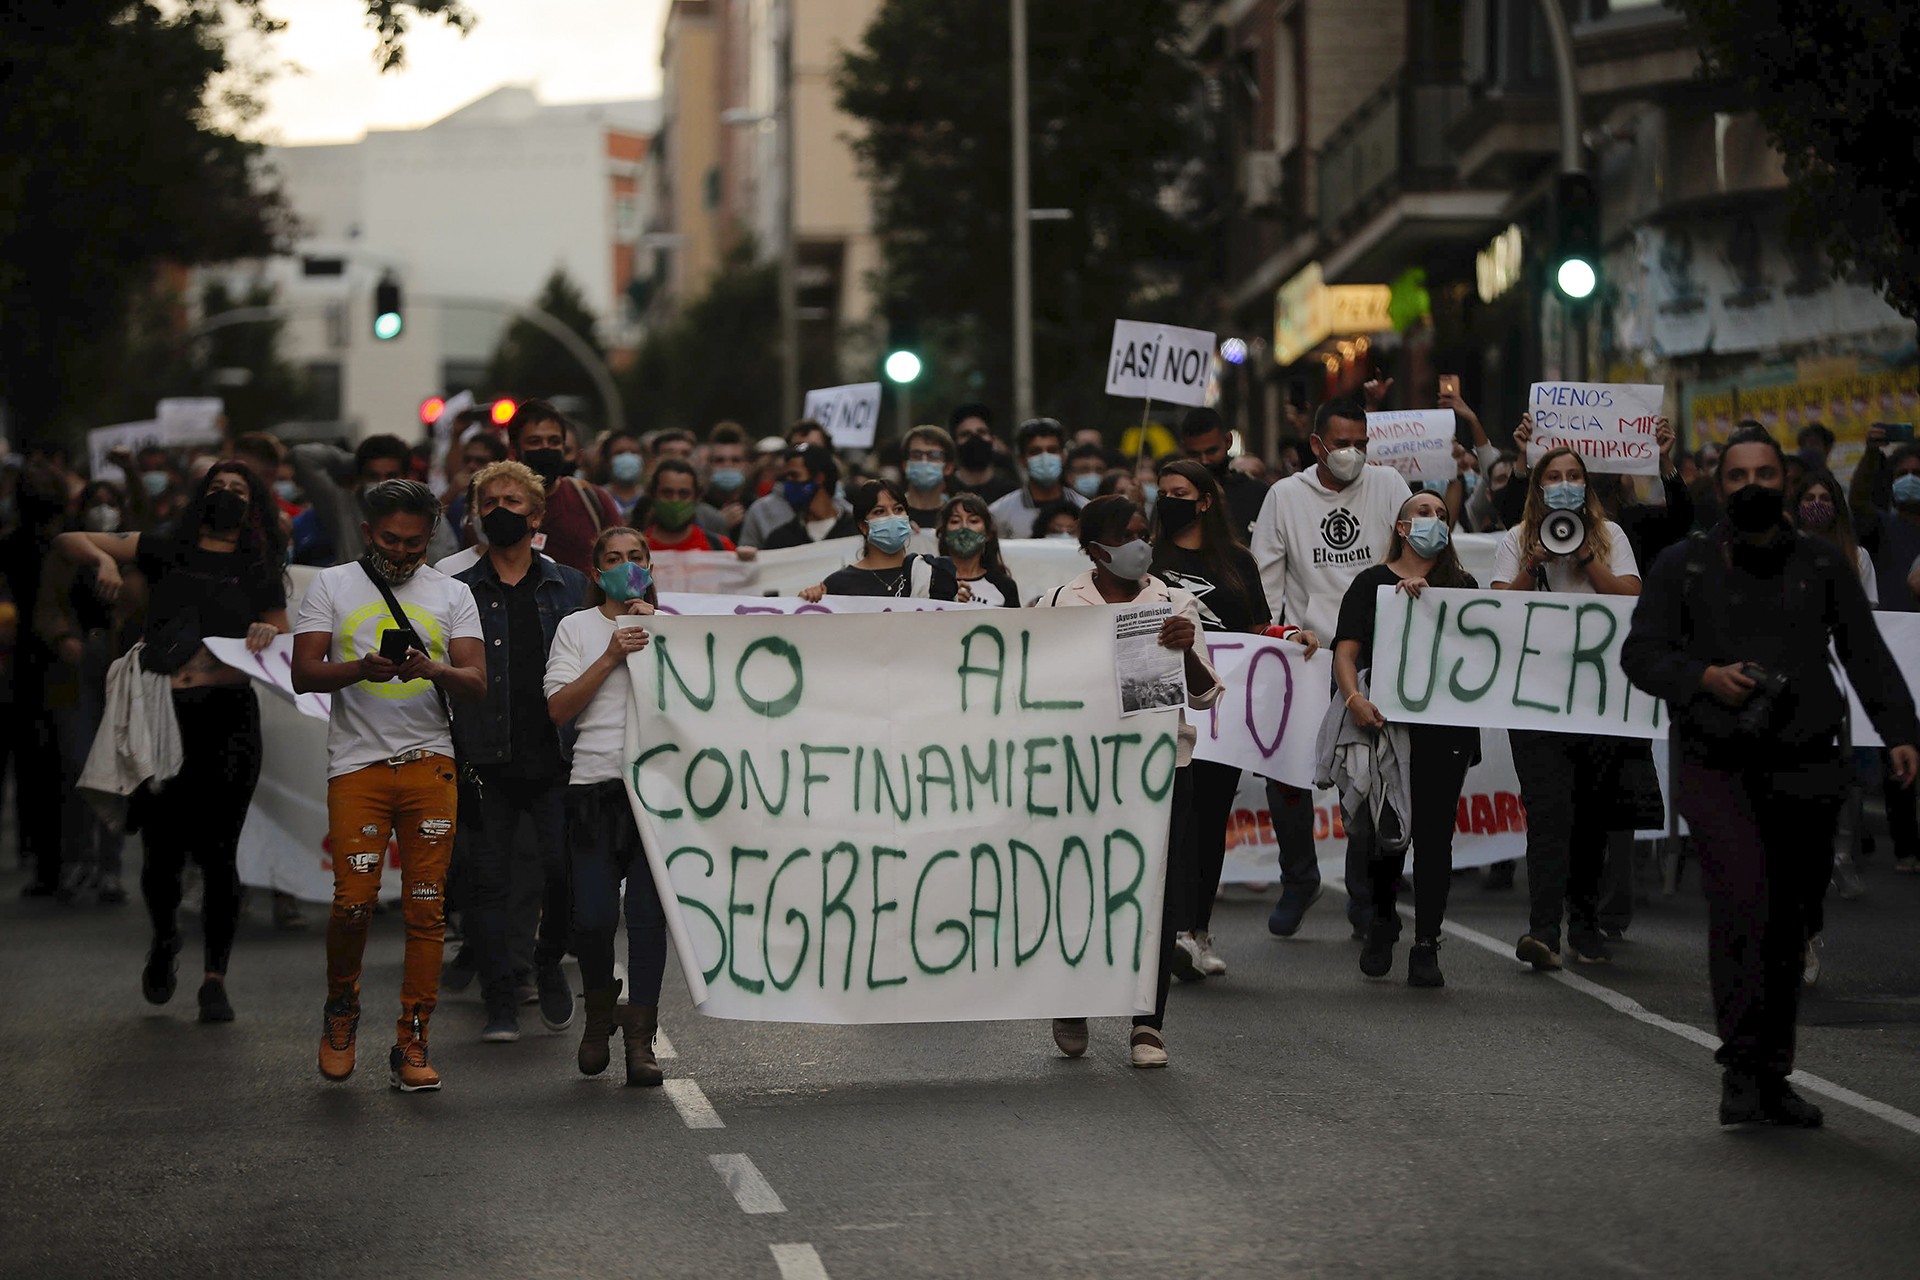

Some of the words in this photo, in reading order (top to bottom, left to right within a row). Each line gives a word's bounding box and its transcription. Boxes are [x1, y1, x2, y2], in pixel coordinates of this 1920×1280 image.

[1112, 333, 1163, 384] ¡ASÍ
[1163, 345, 1208, 387] NO!
[1536, 385, 1613, 408] MENOS
[1367, 421, 1426, 441] ANIDAD
[1535, 410, 1604, 432] POLICIA
[1313, 545, 1371, 563] Element
[1116, 612, 1138, 623] ¡Ayuso
[650, 631, 805, 718] NO
[956, 623, 1086, 716] AL
[630, 731, 1178, 824] CONFINAMIENTO
[664, 827, 1147, 994] SEGREGADOR
